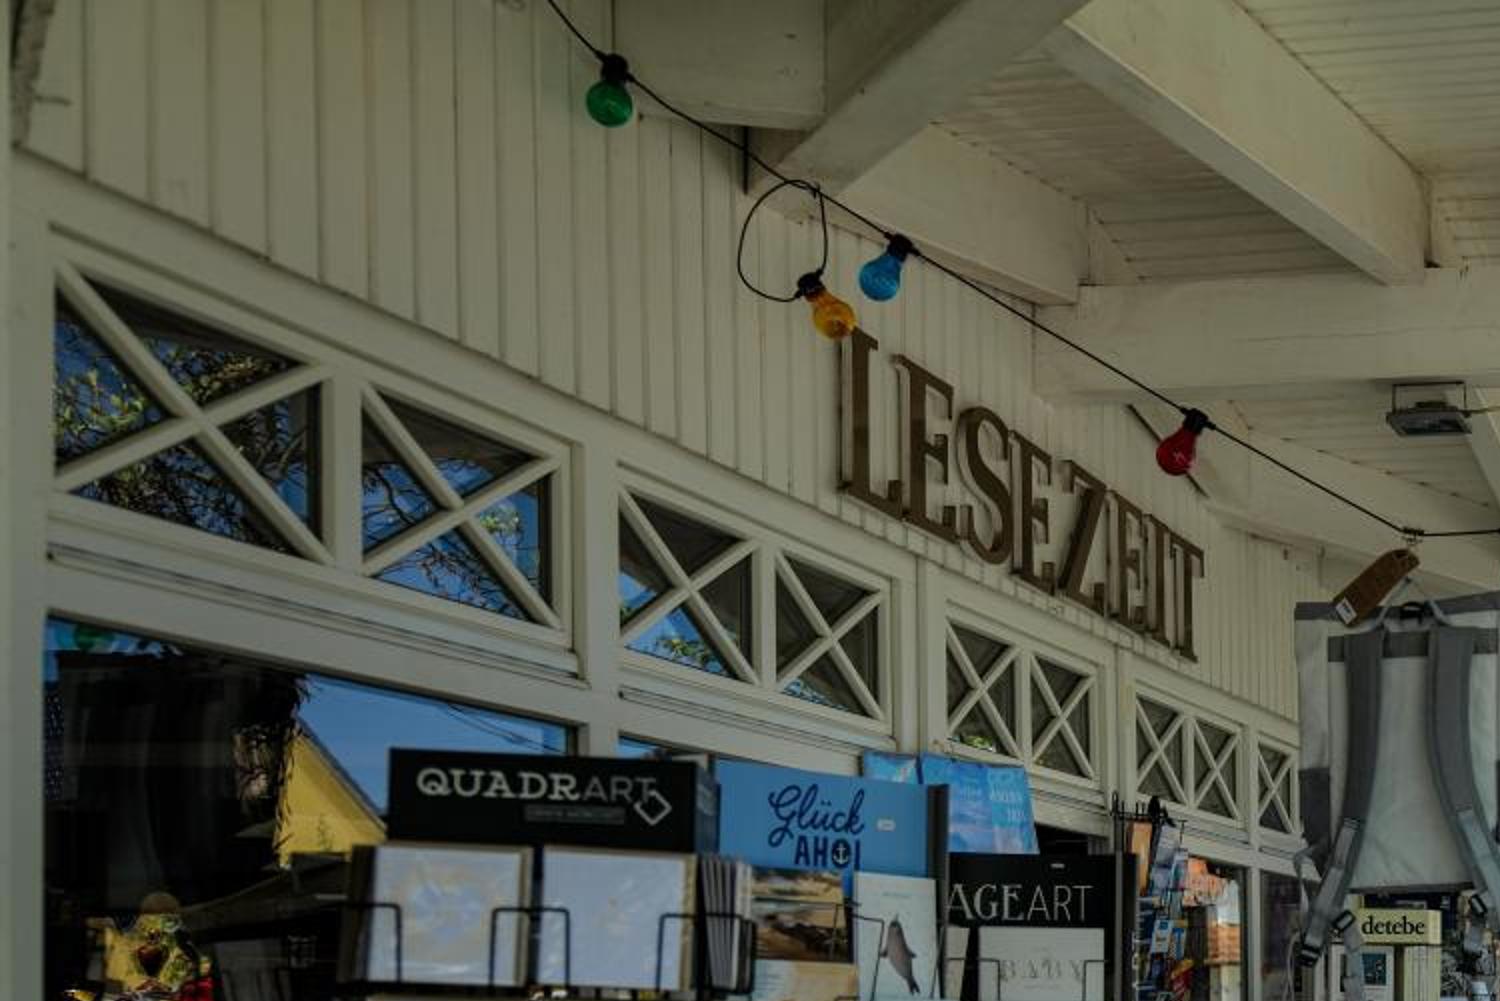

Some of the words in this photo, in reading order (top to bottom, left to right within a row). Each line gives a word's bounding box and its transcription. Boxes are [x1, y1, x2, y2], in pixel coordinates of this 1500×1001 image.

[838, 325, 1205, 662] LESEZEIT
[415, 766, 657, 804] QUADRART
[767, 783, 866, 848] Glück
[794, 835, 861, 869] AHOI
[1361, 915, 1425, 935] detebe
